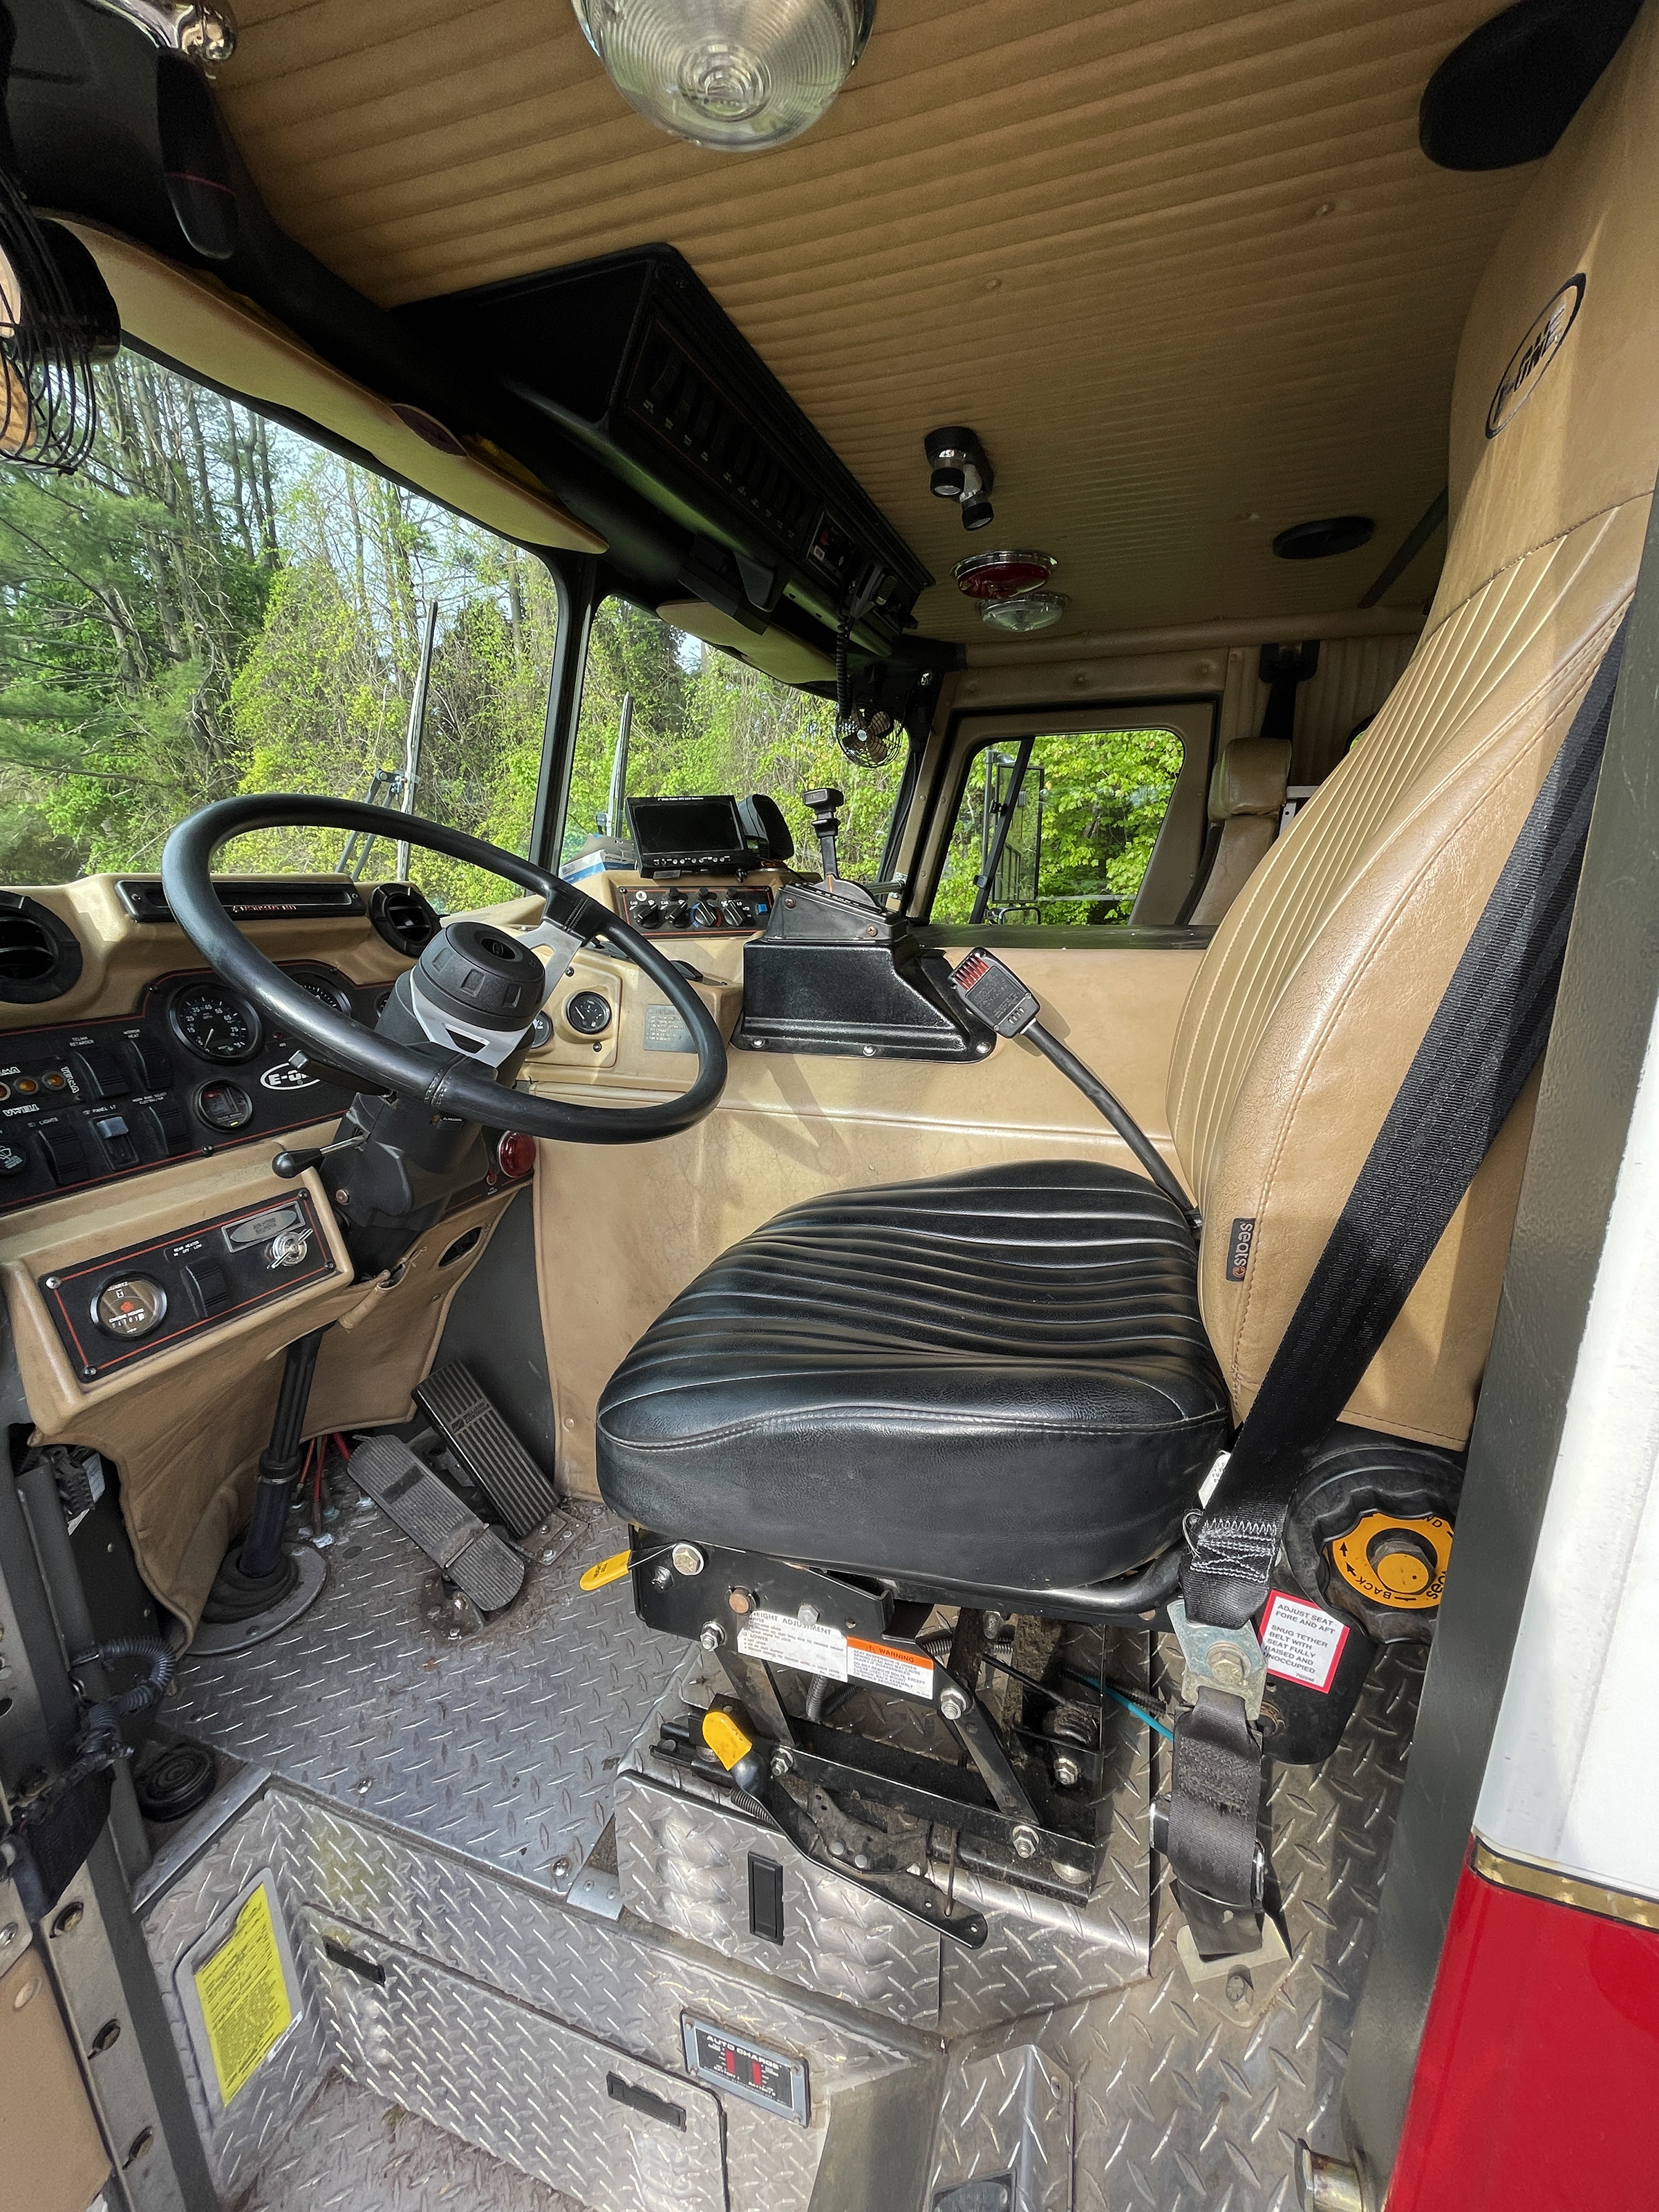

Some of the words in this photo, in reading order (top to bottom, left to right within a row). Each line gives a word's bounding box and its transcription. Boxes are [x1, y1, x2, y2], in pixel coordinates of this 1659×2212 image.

[3, 1104, 39, 1116] TELMA
[39, 1117, 59, 1125] LIGHTS
[1232, 1223, 1253, 1266] seats
[1356, 1576, 1392, 1600] BACK
[1275, 1611, 1298, 1623] FORE
[1299, 1618, 1318, 1629] AND
[1318, 1624, 1335, 1635] AFT
[1277, 1604, 1311, 1619] ADJUST
[1311, 1615, 1334, 1627] SEAT
[750, 1633, 769, 1642] LOWER
[1269, 1631, 1291, 1642] BELT
[1291, 1638, 1312, 1650] WITH
[1271, 1624, 1295, 1637] SNUG
[1297, 1632, 1329, 1648] TETHER
[879, 1647, 915, 1663] WARNING
[1264, 1644, 1295, 1660] RAISED
[1295, 1656, 1314, 1666] AND
[1266, 1638, 1287, 1649] SEAT
[1289, 1645, 1316, 1658] FULLY
[865, 1653, 894, 1664] SUSPENSION
[1263, 1651, 1315, 1674] UNOCCUPIED
[871, 1666, 890, 1674] REMOVE
[908, 1676, 925, 1685] EXCEPT
[889, 1674, 906, 1683] MOUNT
[889, 1678, 913, 1688] ASSEMBLY
[706, 2035, 735, 2051] AUTO
[736, 2047, 780, 2070] CHARGE
